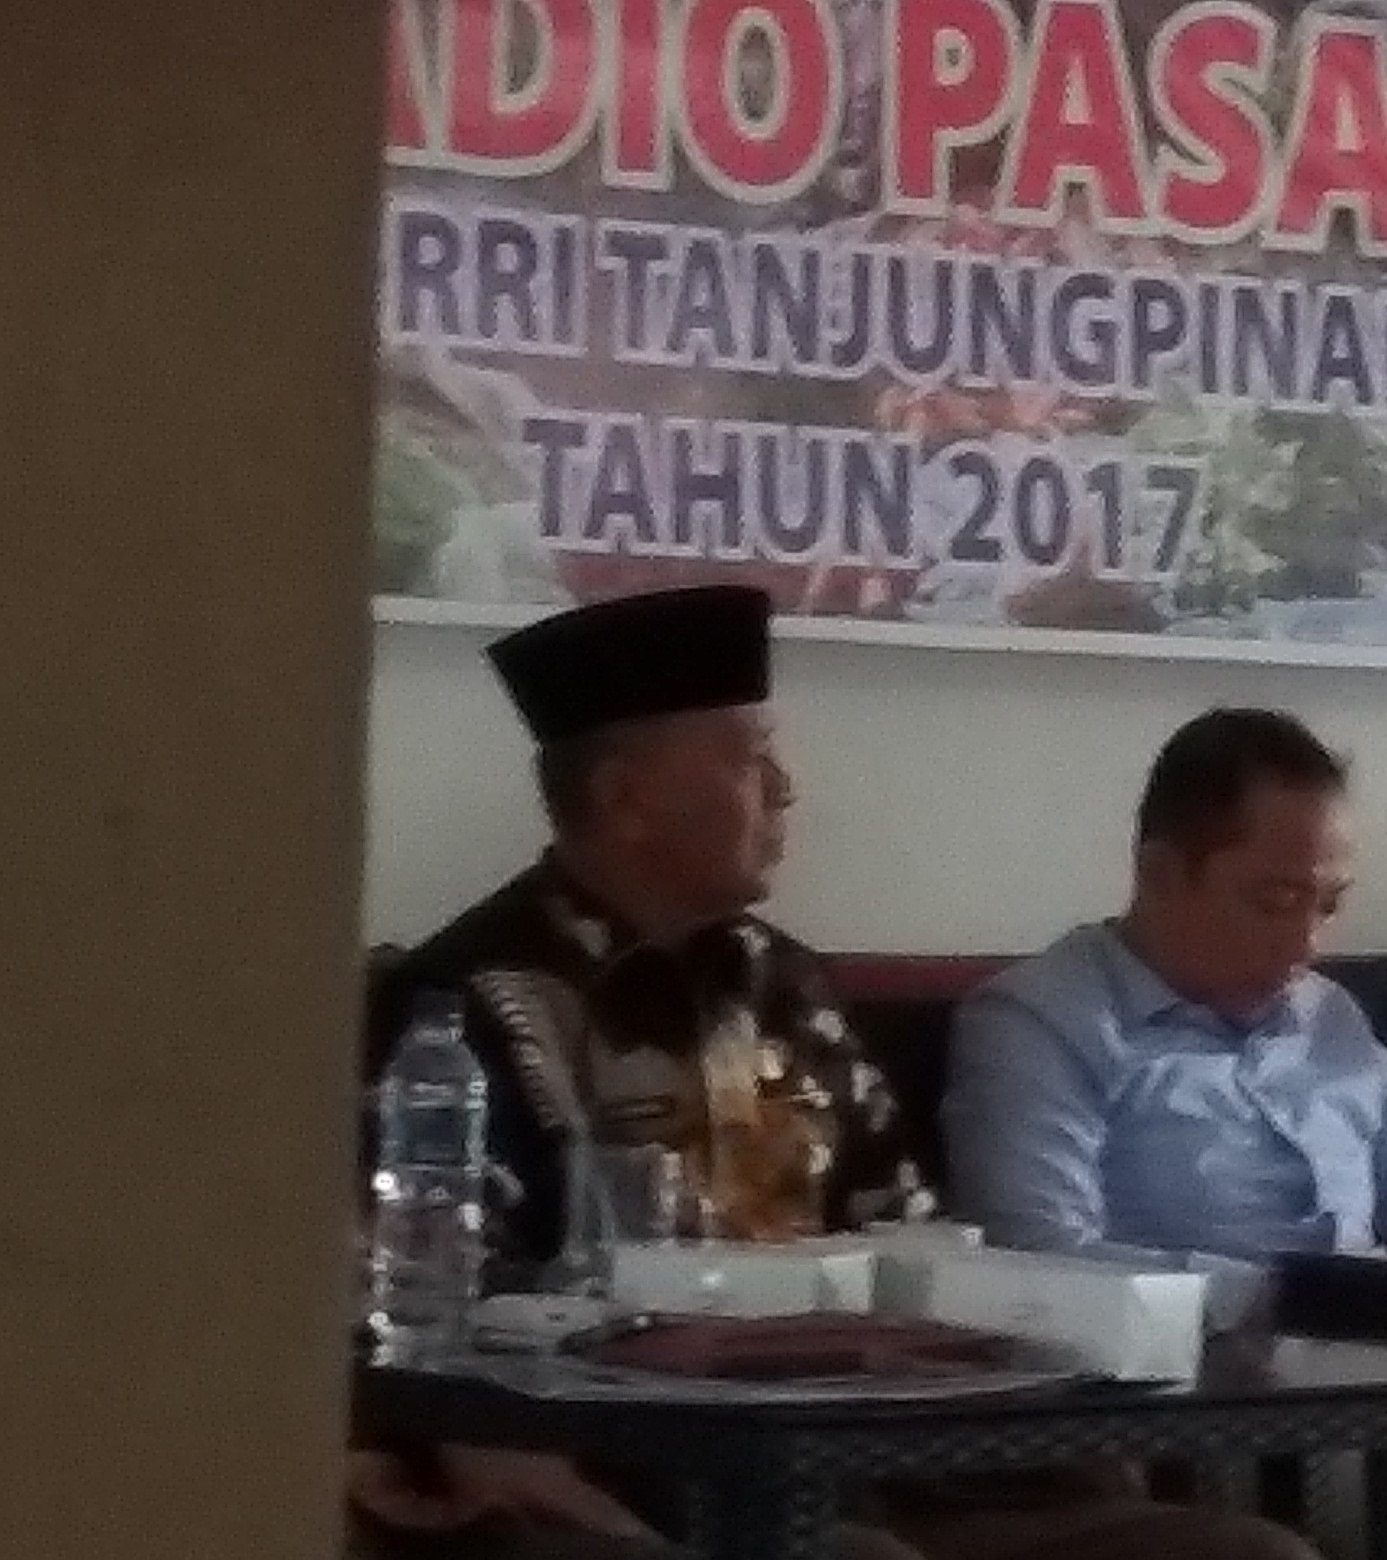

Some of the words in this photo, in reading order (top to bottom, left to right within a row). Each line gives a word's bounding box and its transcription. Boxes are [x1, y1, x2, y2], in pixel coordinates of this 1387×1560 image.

[400, 210, 576, 340] RRI
[523, 416, 912, 560] TAHUN
[950, 450, 1192, 578] 2017
